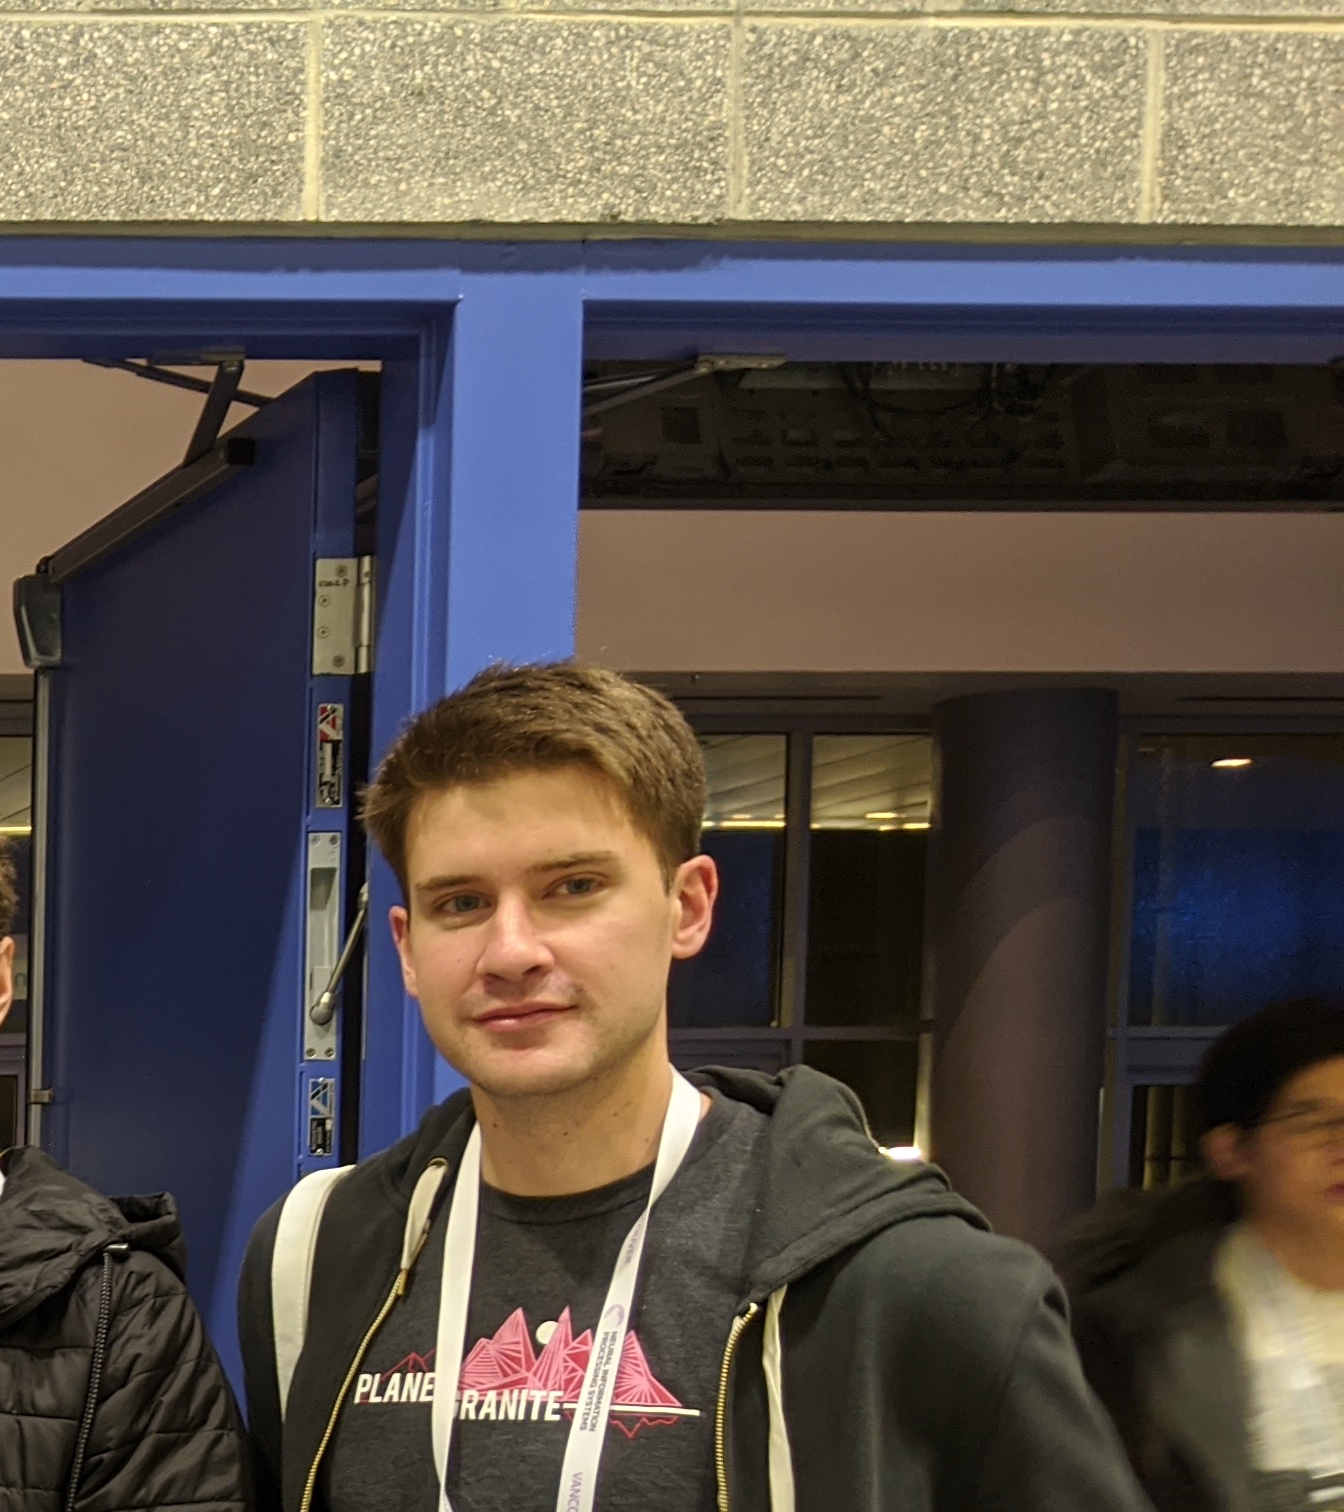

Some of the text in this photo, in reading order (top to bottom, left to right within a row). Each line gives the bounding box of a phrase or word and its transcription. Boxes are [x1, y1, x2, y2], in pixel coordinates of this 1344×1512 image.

[354, 1372, 435, 1404] PLANE
[580, 1331, 610, 1431] PROCESSING SYSTEMS
[588, 1331, 618, 1432] NEURAL INFORMATION
